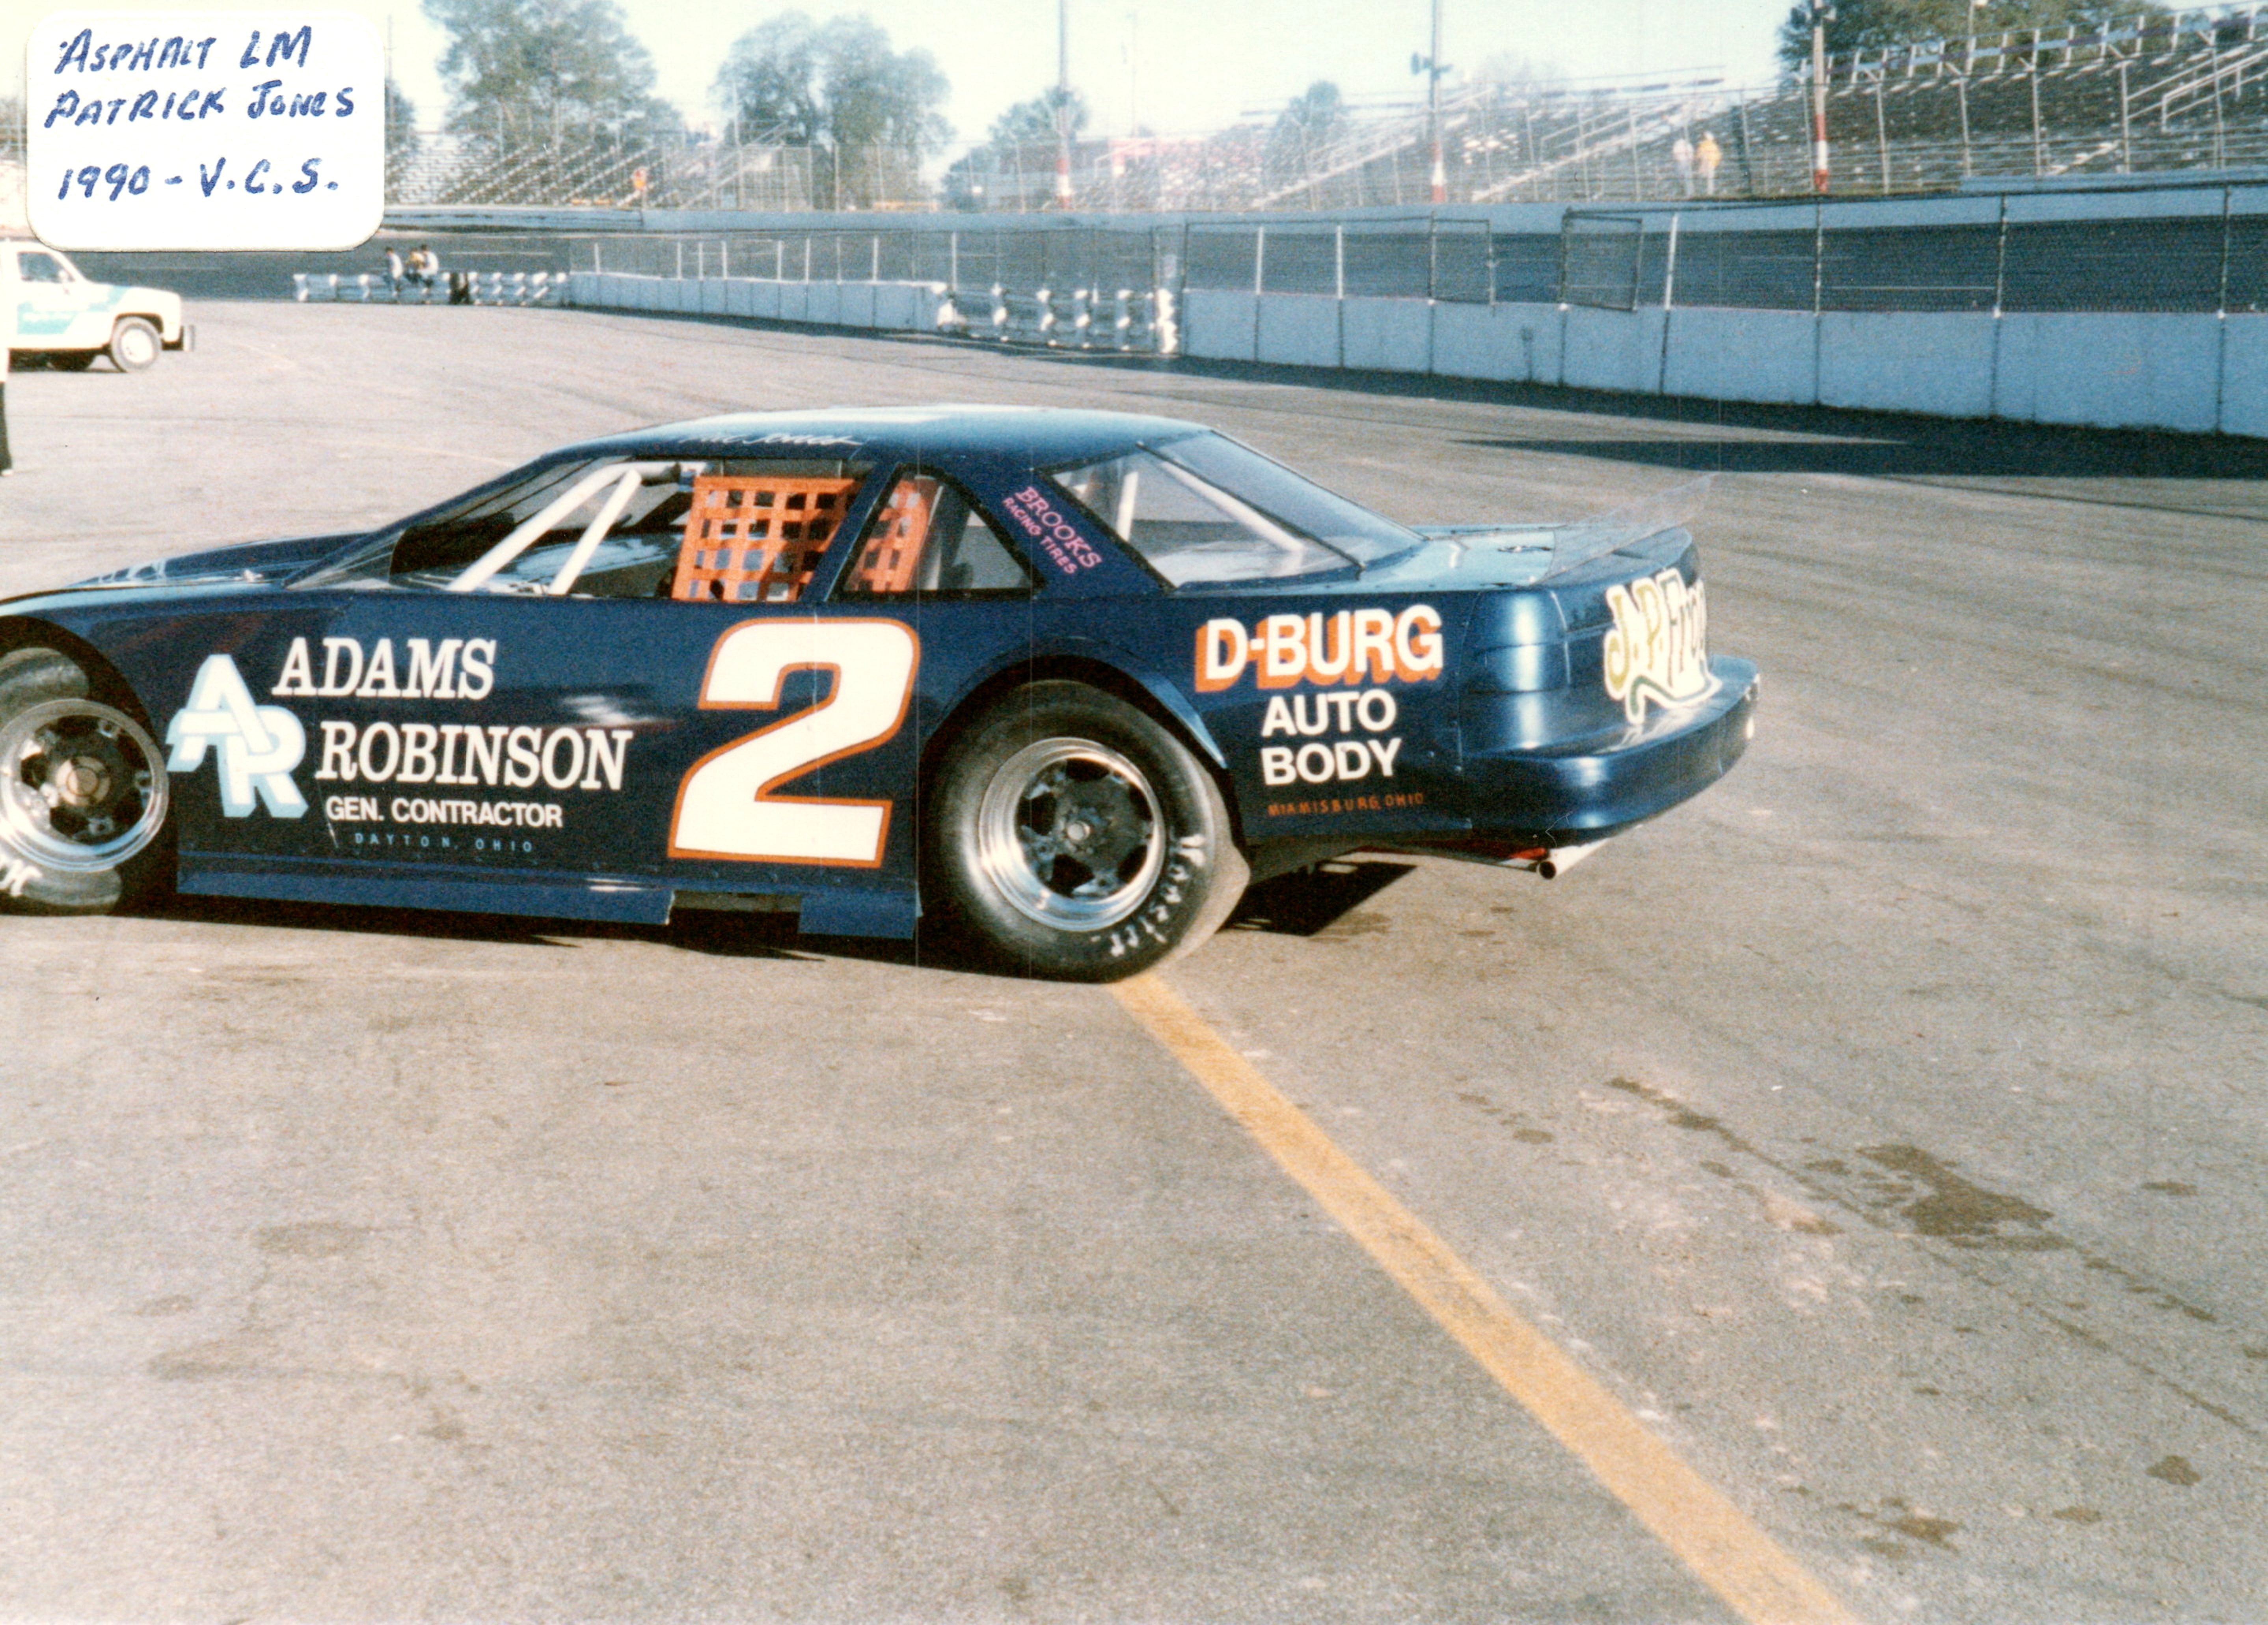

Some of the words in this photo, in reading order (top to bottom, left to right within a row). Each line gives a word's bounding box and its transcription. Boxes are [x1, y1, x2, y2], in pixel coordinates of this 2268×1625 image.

[1002, 497, 1042, 536] RACING
[1039, 535, 1078, 574] TIRES
[1015, 486, 1102, 568] BROOKS
[272, 637, 496, 700] ADAMS
[1195, 604, 1443, 693] D-BURG
[668, 616, 921, 868] 2
[1261, 689, 1397, 737] AUTO
[315, 721, 634, 790] ROBINSON
[1261, 738, 1402, 785] BODY
[326, 796, 384, 820] GEN.
[391, 798, 562, 827] CONTRACTOR
[1385, 793, 1424, 807] OHIO
[475, 839, 532, 852] OHIO
